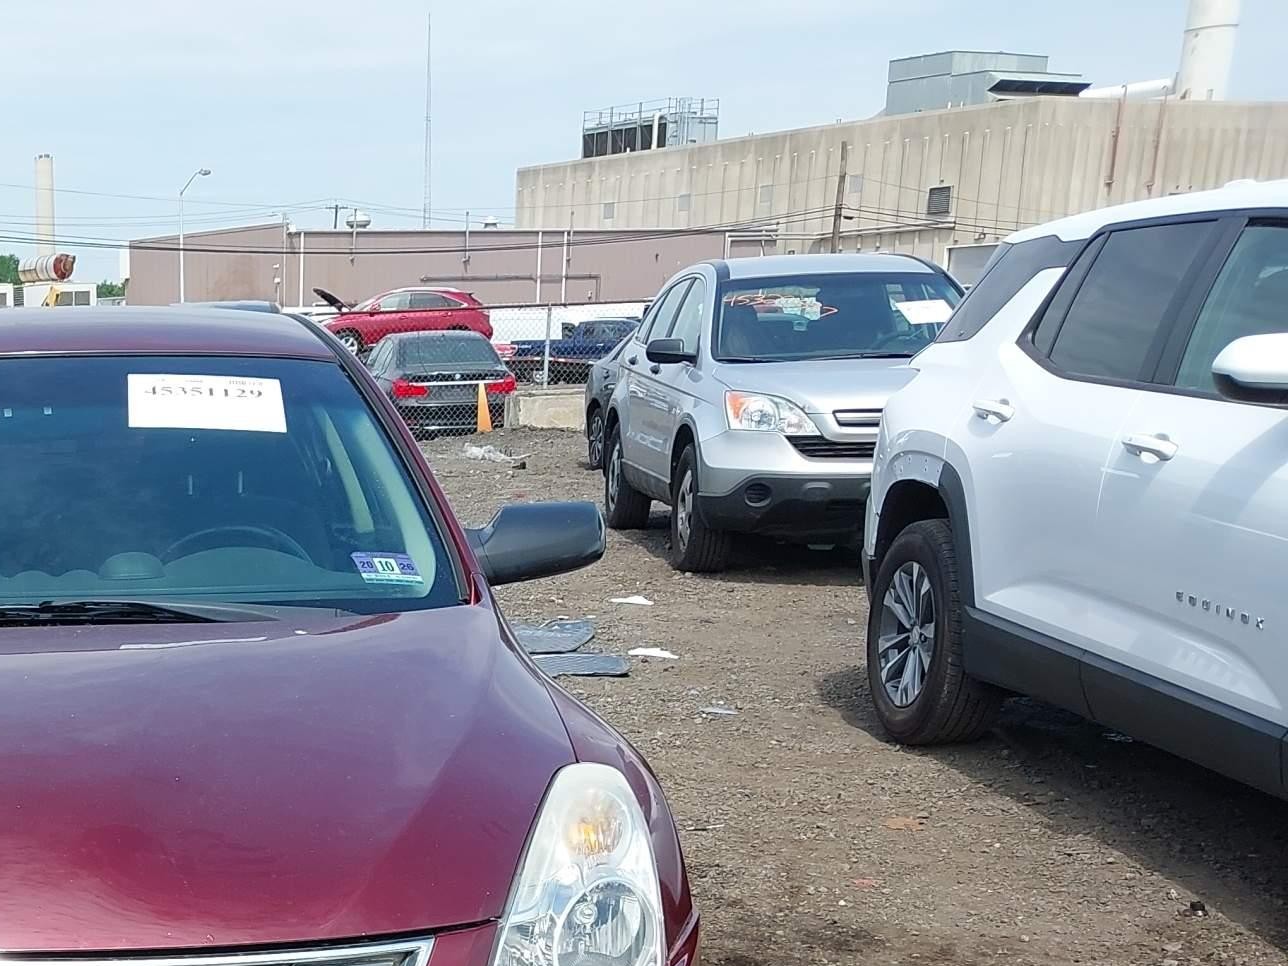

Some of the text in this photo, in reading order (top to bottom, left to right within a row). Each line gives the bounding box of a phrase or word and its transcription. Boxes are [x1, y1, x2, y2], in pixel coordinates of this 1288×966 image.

[144, 386, 263, 398] 45351129
[359, 560, 415, 572] 20 10 26
